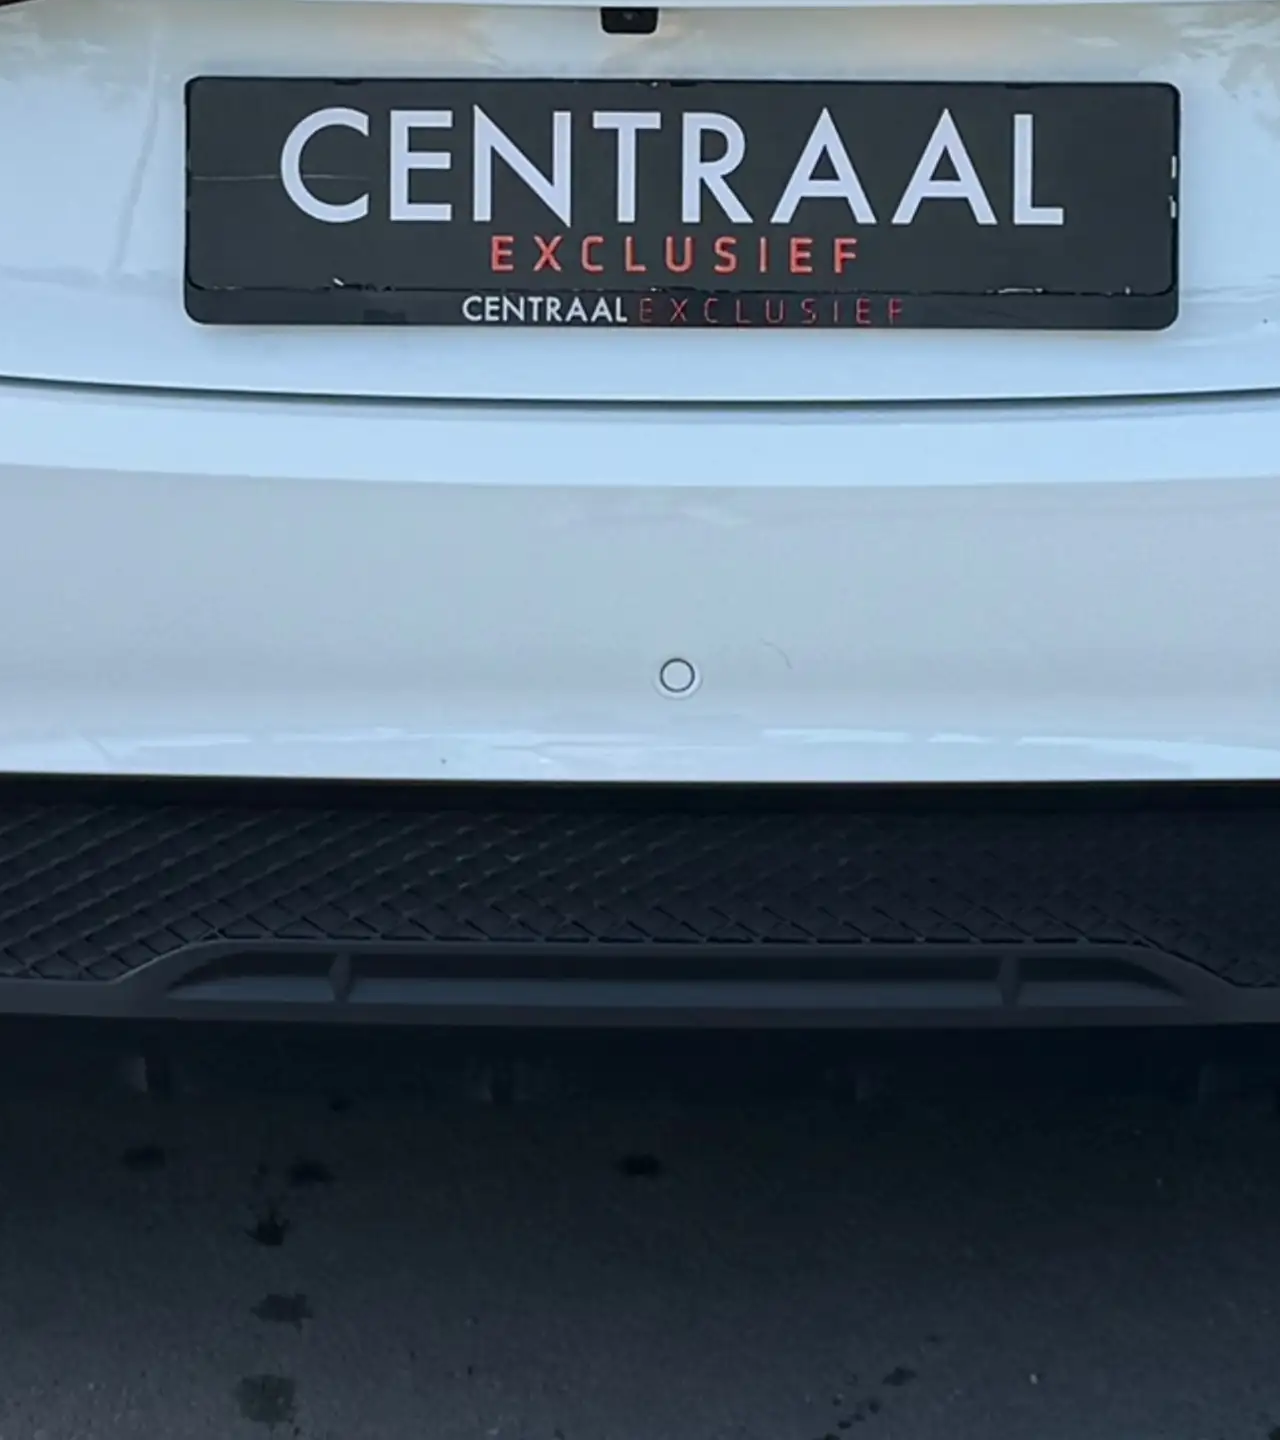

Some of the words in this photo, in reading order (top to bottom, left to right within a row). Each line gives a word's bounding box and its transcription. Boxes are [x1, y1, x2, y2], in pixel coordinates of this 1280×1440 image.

[280, 104, 1066, 228] CENTRAAL
[490, 235, 858, 274] EXCLUSIEF
[461, 294, 628, 323] CENTRAAL
[638, 296, 904, 325] EXCLUSIEF
